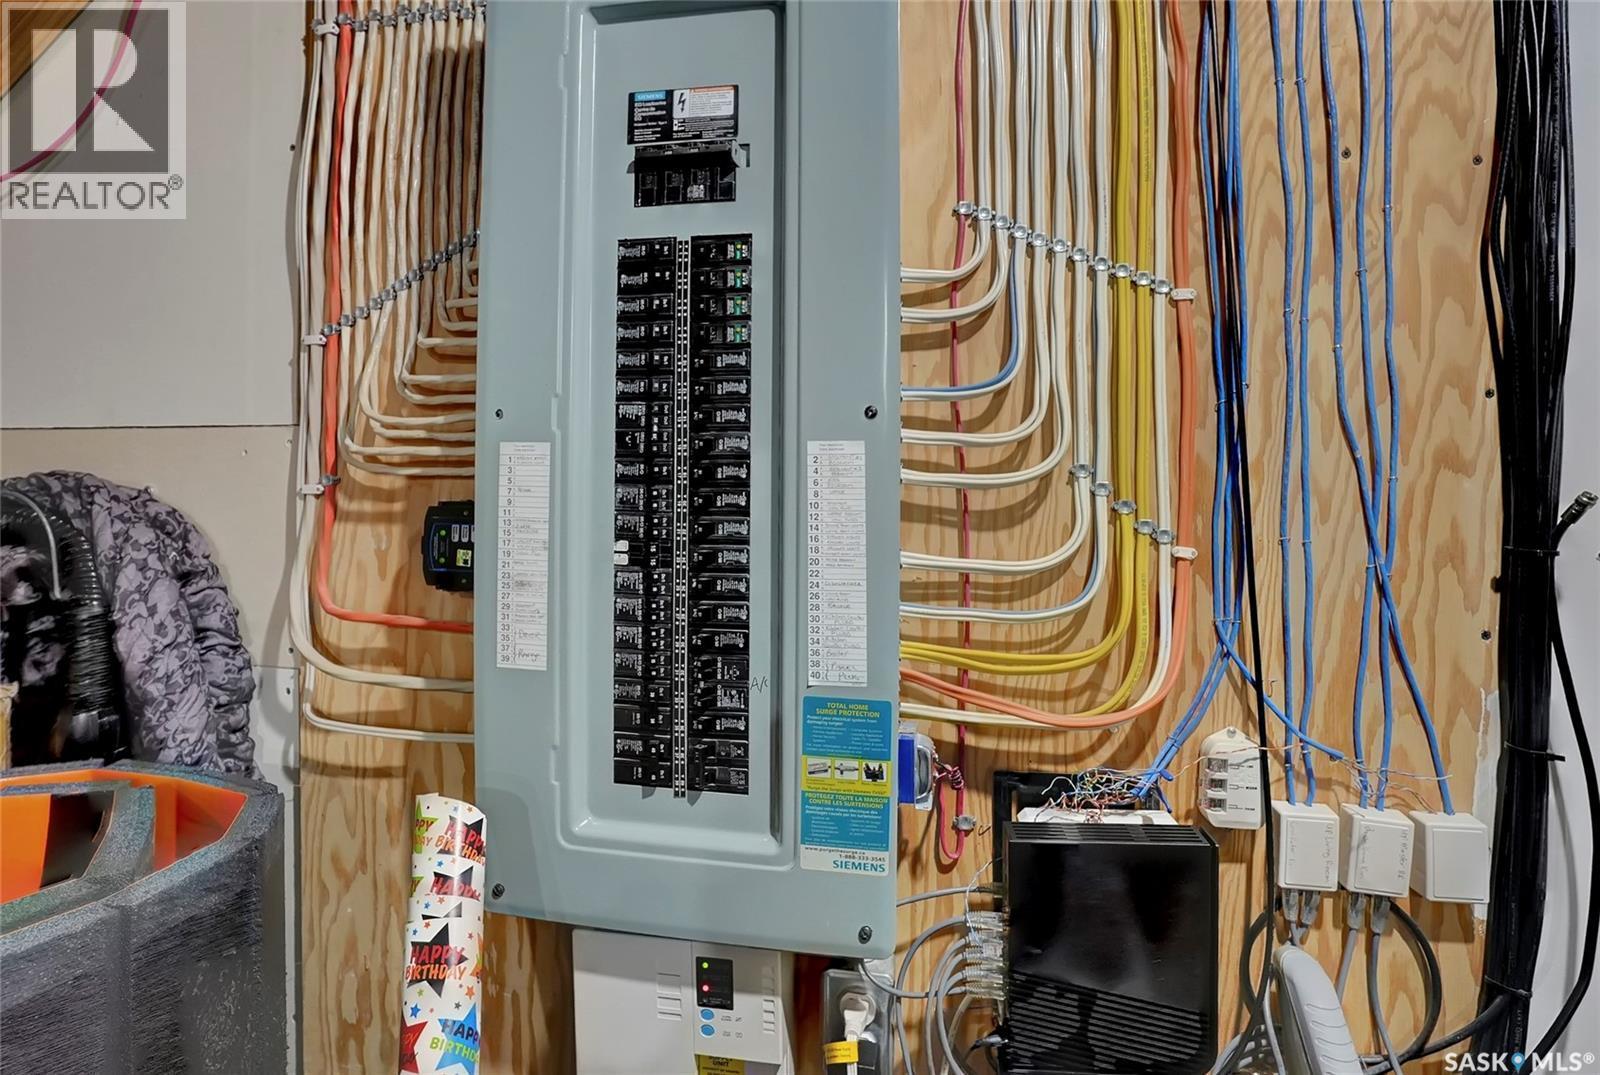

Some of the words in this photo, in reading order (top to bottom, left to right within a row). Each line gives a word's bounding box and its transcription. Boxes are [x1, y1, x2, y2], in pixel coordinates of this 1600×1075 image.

[813, 456, 819, 464] 2
[507, 466, 513, 474] 3
[813, 467, 819, 475] 4
[813, 479, 819, 487] 6
[507, 487, 512, 495] 7
[813, 490, 819, 498] 8
[507, 498, 512, 506] 9
[809, 502, 819, 510] 10
[809, 513, 819, 521] 12
[503, 519, 511, 527] 13
[809, 524, 819, 532] 14
[503, 529, 511, 537] 15
[502, 539, 511, 547] 17
[809, 535, 819, 543] 16
[502, 550, 511, 558] 19
[809, 546, 820, 554] 18
[809, 557, 820, 566] 20
[501, 571, 511, 579] 23
[809, 581, 820, 589] 24
[501, 592, 510, 600] 27
[809, 592, 820, 600] 26
[501, 613, 510, 621] 31
[809, 626, 820, 634] 32
[501, 634, 510, 642] 35
[501, 644, 510, 652] 37
[827, 702, 847, 710] TOTAL
[848, 703, 868, 711] HOME
[839, 709, 880, 718] PROTECTION
[832, 860, 886, 873] SIEMENS
[410, 945, 465, 965] HAPPY
[405, 964, 467, 980] BIRTHDAY
